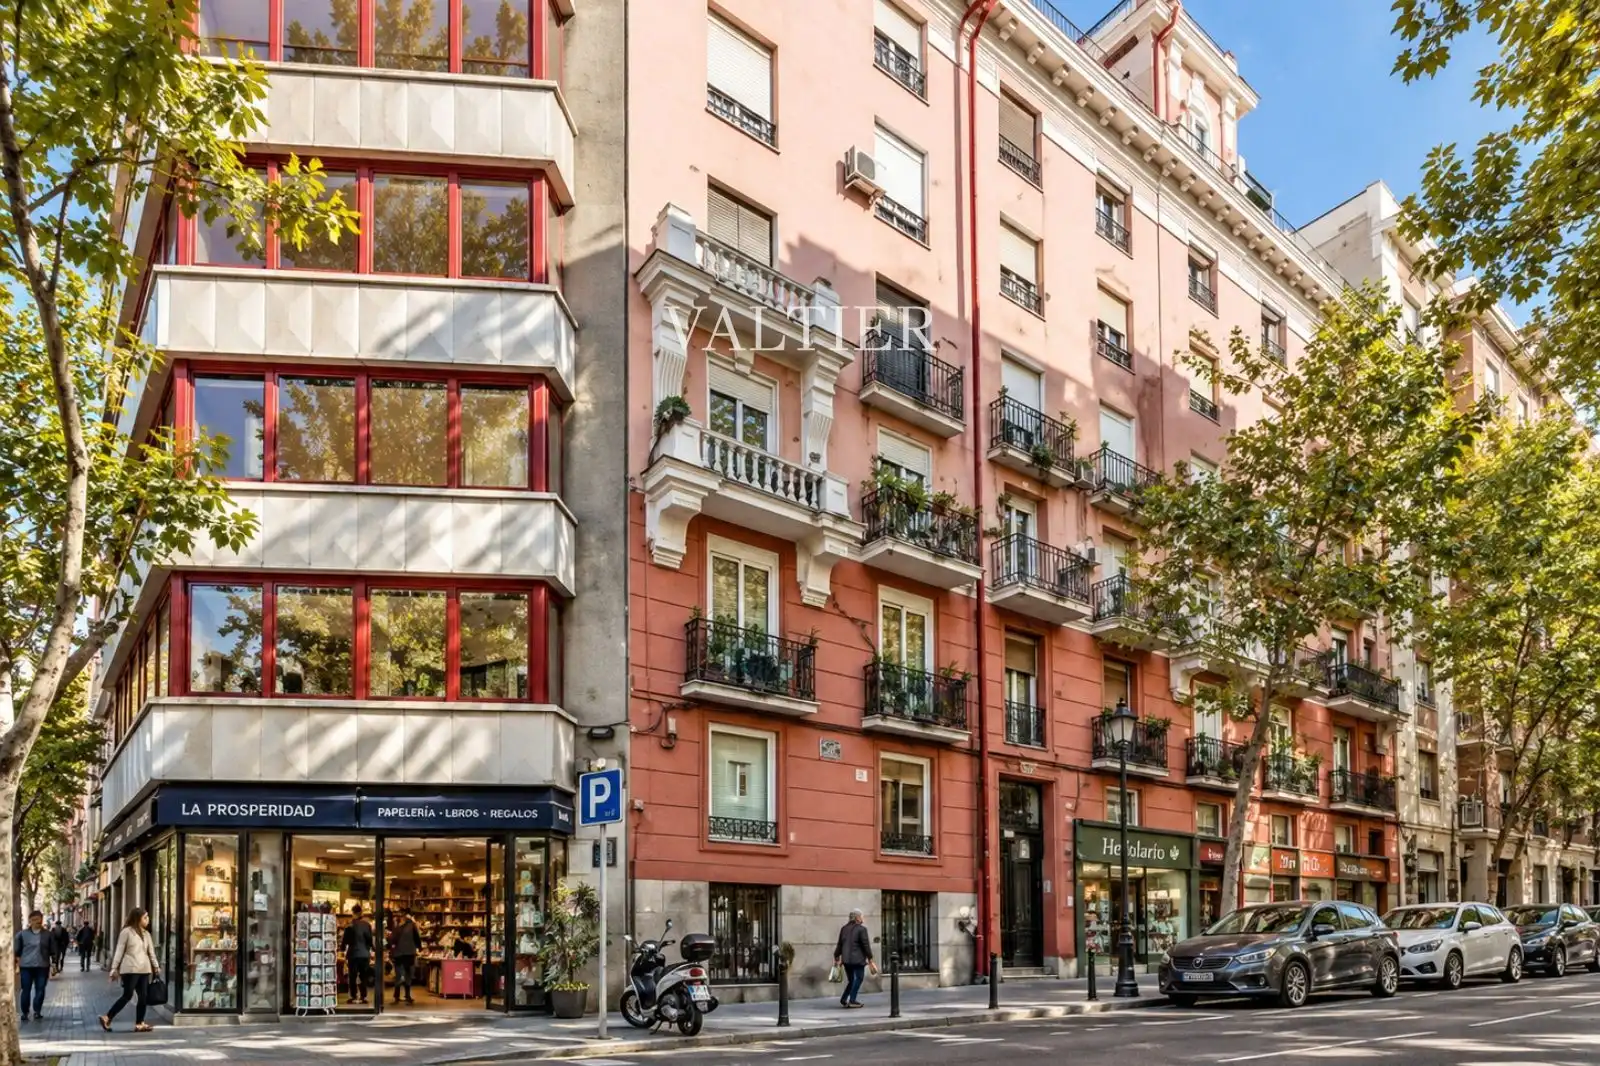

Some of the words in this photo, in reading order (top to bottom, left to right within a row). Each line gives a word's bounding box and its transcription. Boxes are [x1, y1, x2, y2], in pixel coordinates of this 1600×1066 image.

[589, 776, 611, 818] P
[182, 803, 201, 816] LA
[207, 803, 315, 817] PROSPERIDAD
[378, 805, 436, 818] PAPELERÍA
[490, 809, 538, 819] REGALOS
